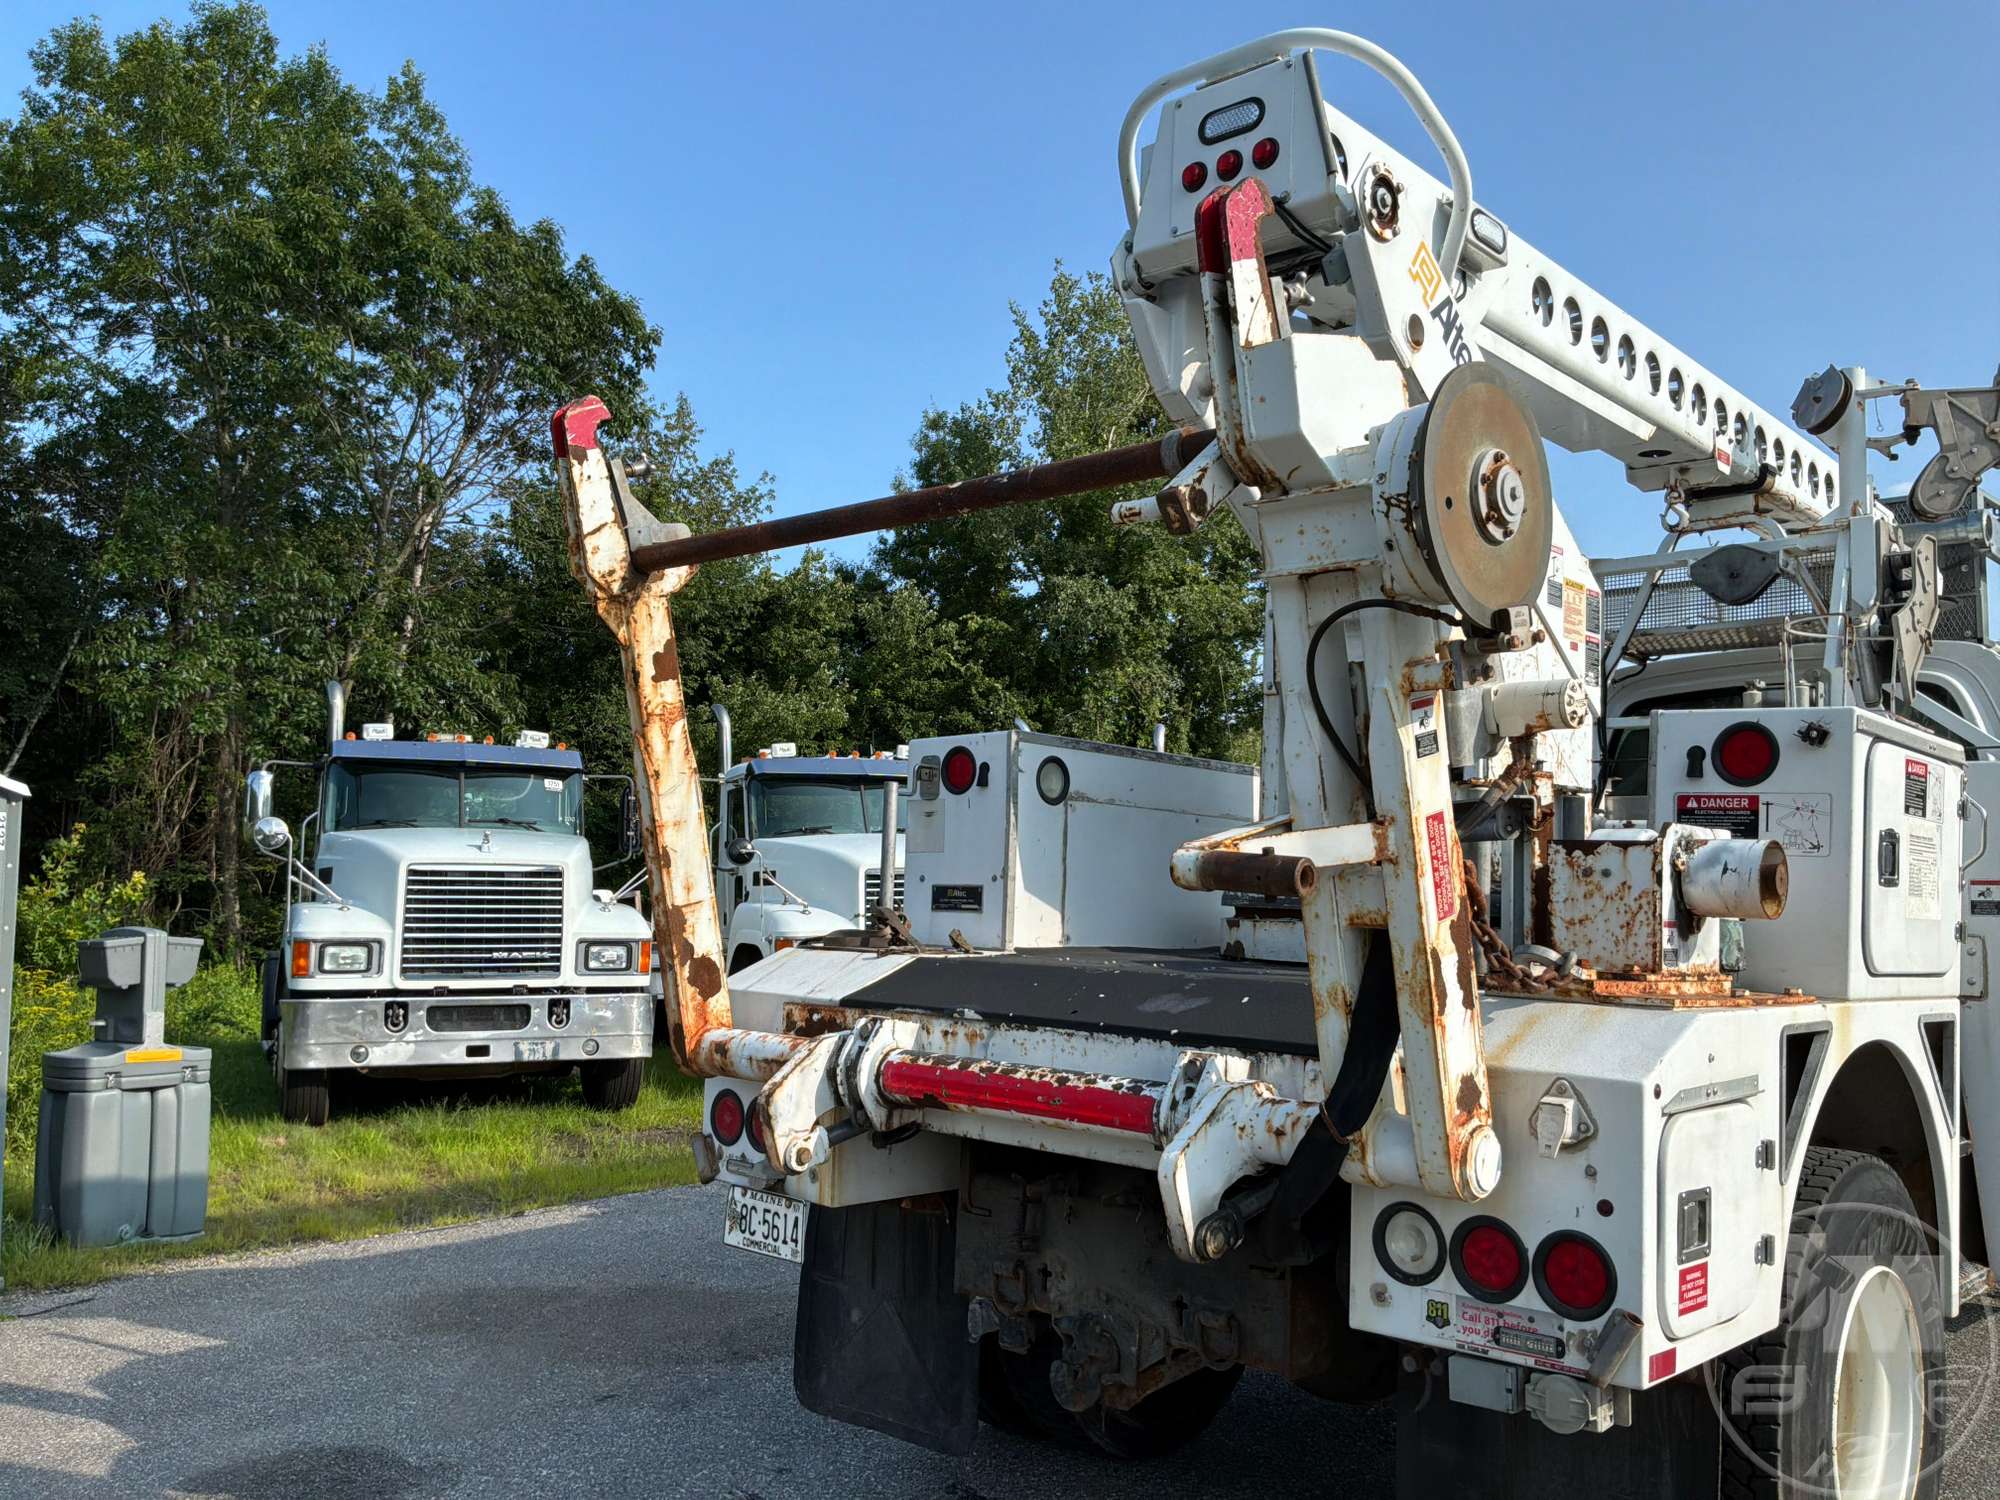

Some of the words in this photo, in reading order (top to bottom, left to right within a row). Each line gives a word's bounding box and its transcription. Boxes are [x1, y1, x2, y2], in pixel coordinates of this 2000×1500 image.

[1430, 295, 1472, 365] Alte
[1700, 797, 1749, 809] DANGER
[1438, 822, 1448, 862] MAXIMUM
[1435, 886, 1444, 919] RADIUS
[492, 951, 551, 959] MACK
[750, 1192, 783, 1206] MAINE
[742, 1236, 781, 1256] COMMERCIAL
[1428, 1300, 1448, 1320] 811
[1462, 1311, 1481, 1323] Call
[1484, 1315, 1500, 1327] 811
[1504, 1319, 1538, 1333] before
[1462, 1325, 1480, 1334] you
